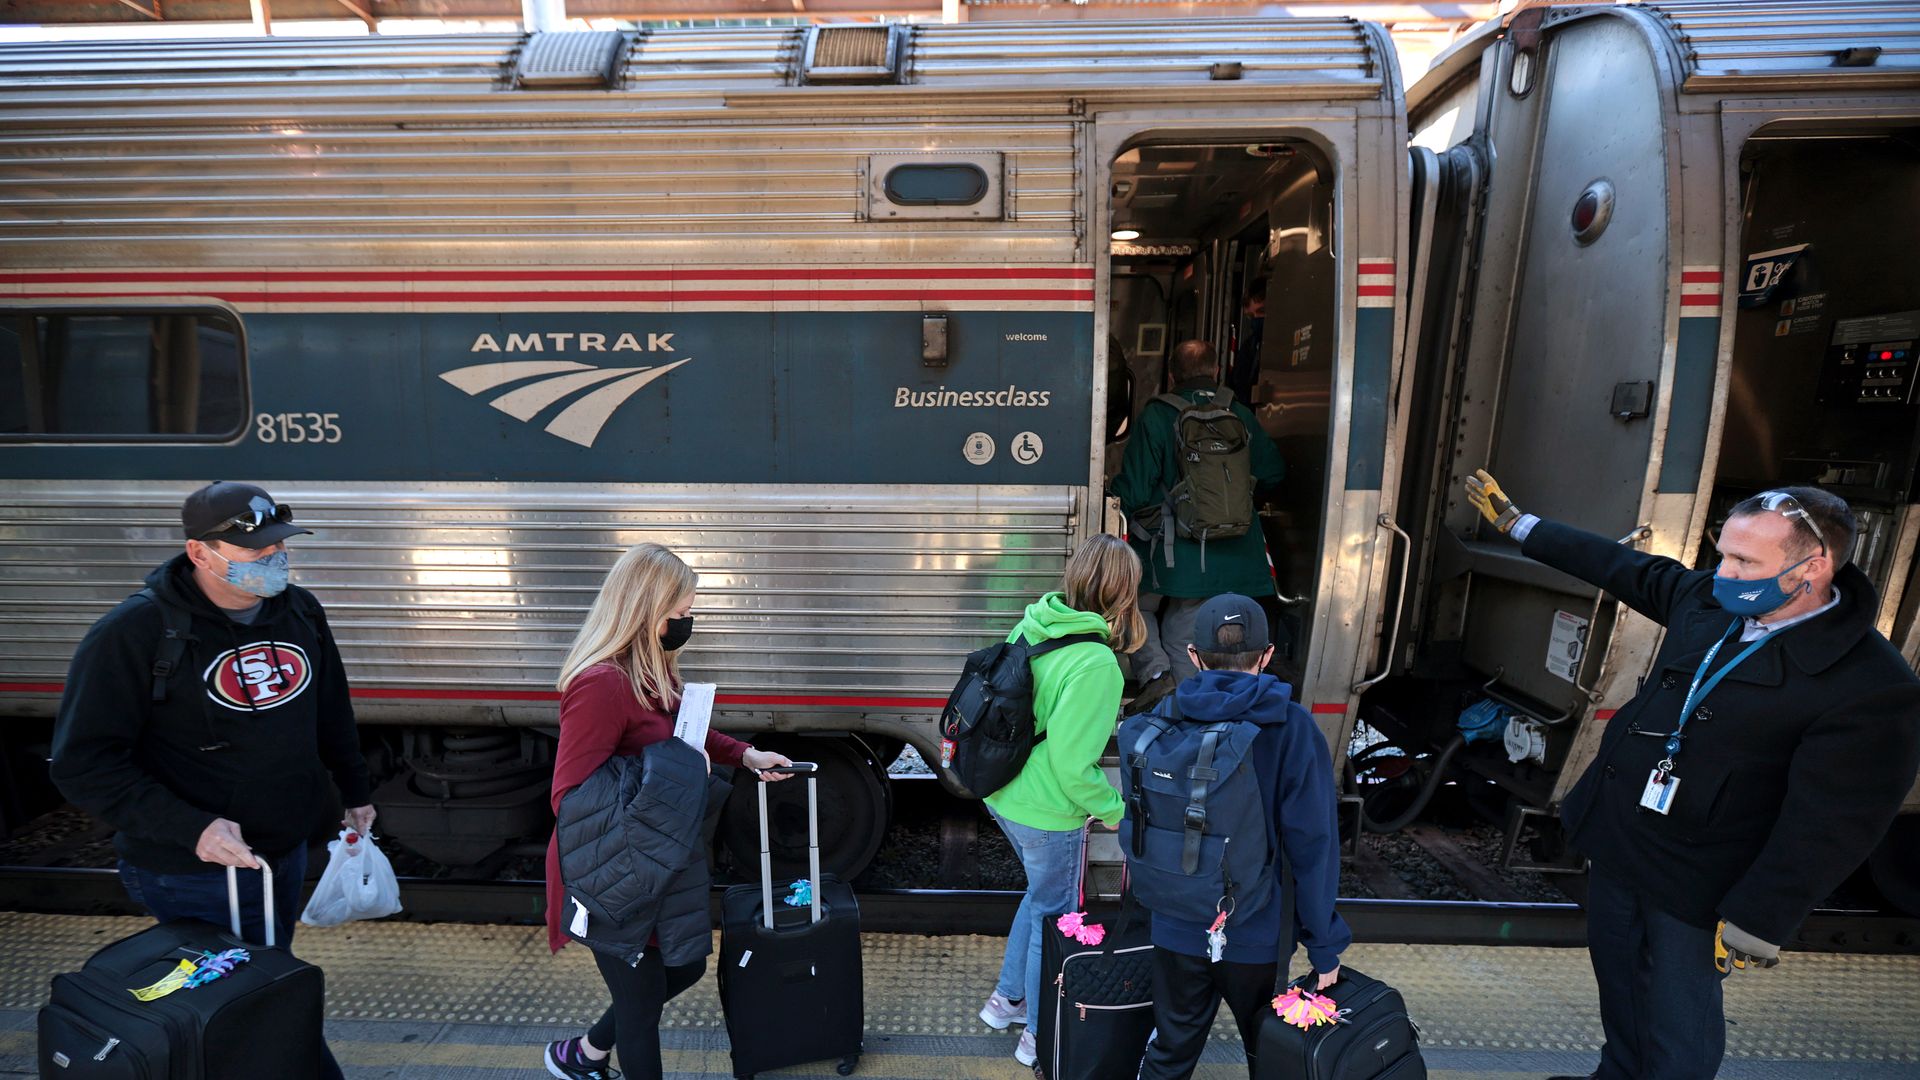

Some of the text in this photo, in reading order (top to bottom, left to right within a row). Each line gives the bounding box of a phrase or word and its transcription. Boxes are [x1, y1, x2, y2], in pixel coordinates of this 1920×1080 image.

[471, 332, 676, 352] AMTRAK
[1005, 332, 1048, 341] welcome
[894, 385, 1051, 407] Businessclass
[256, 412, 342, 443] 81535
